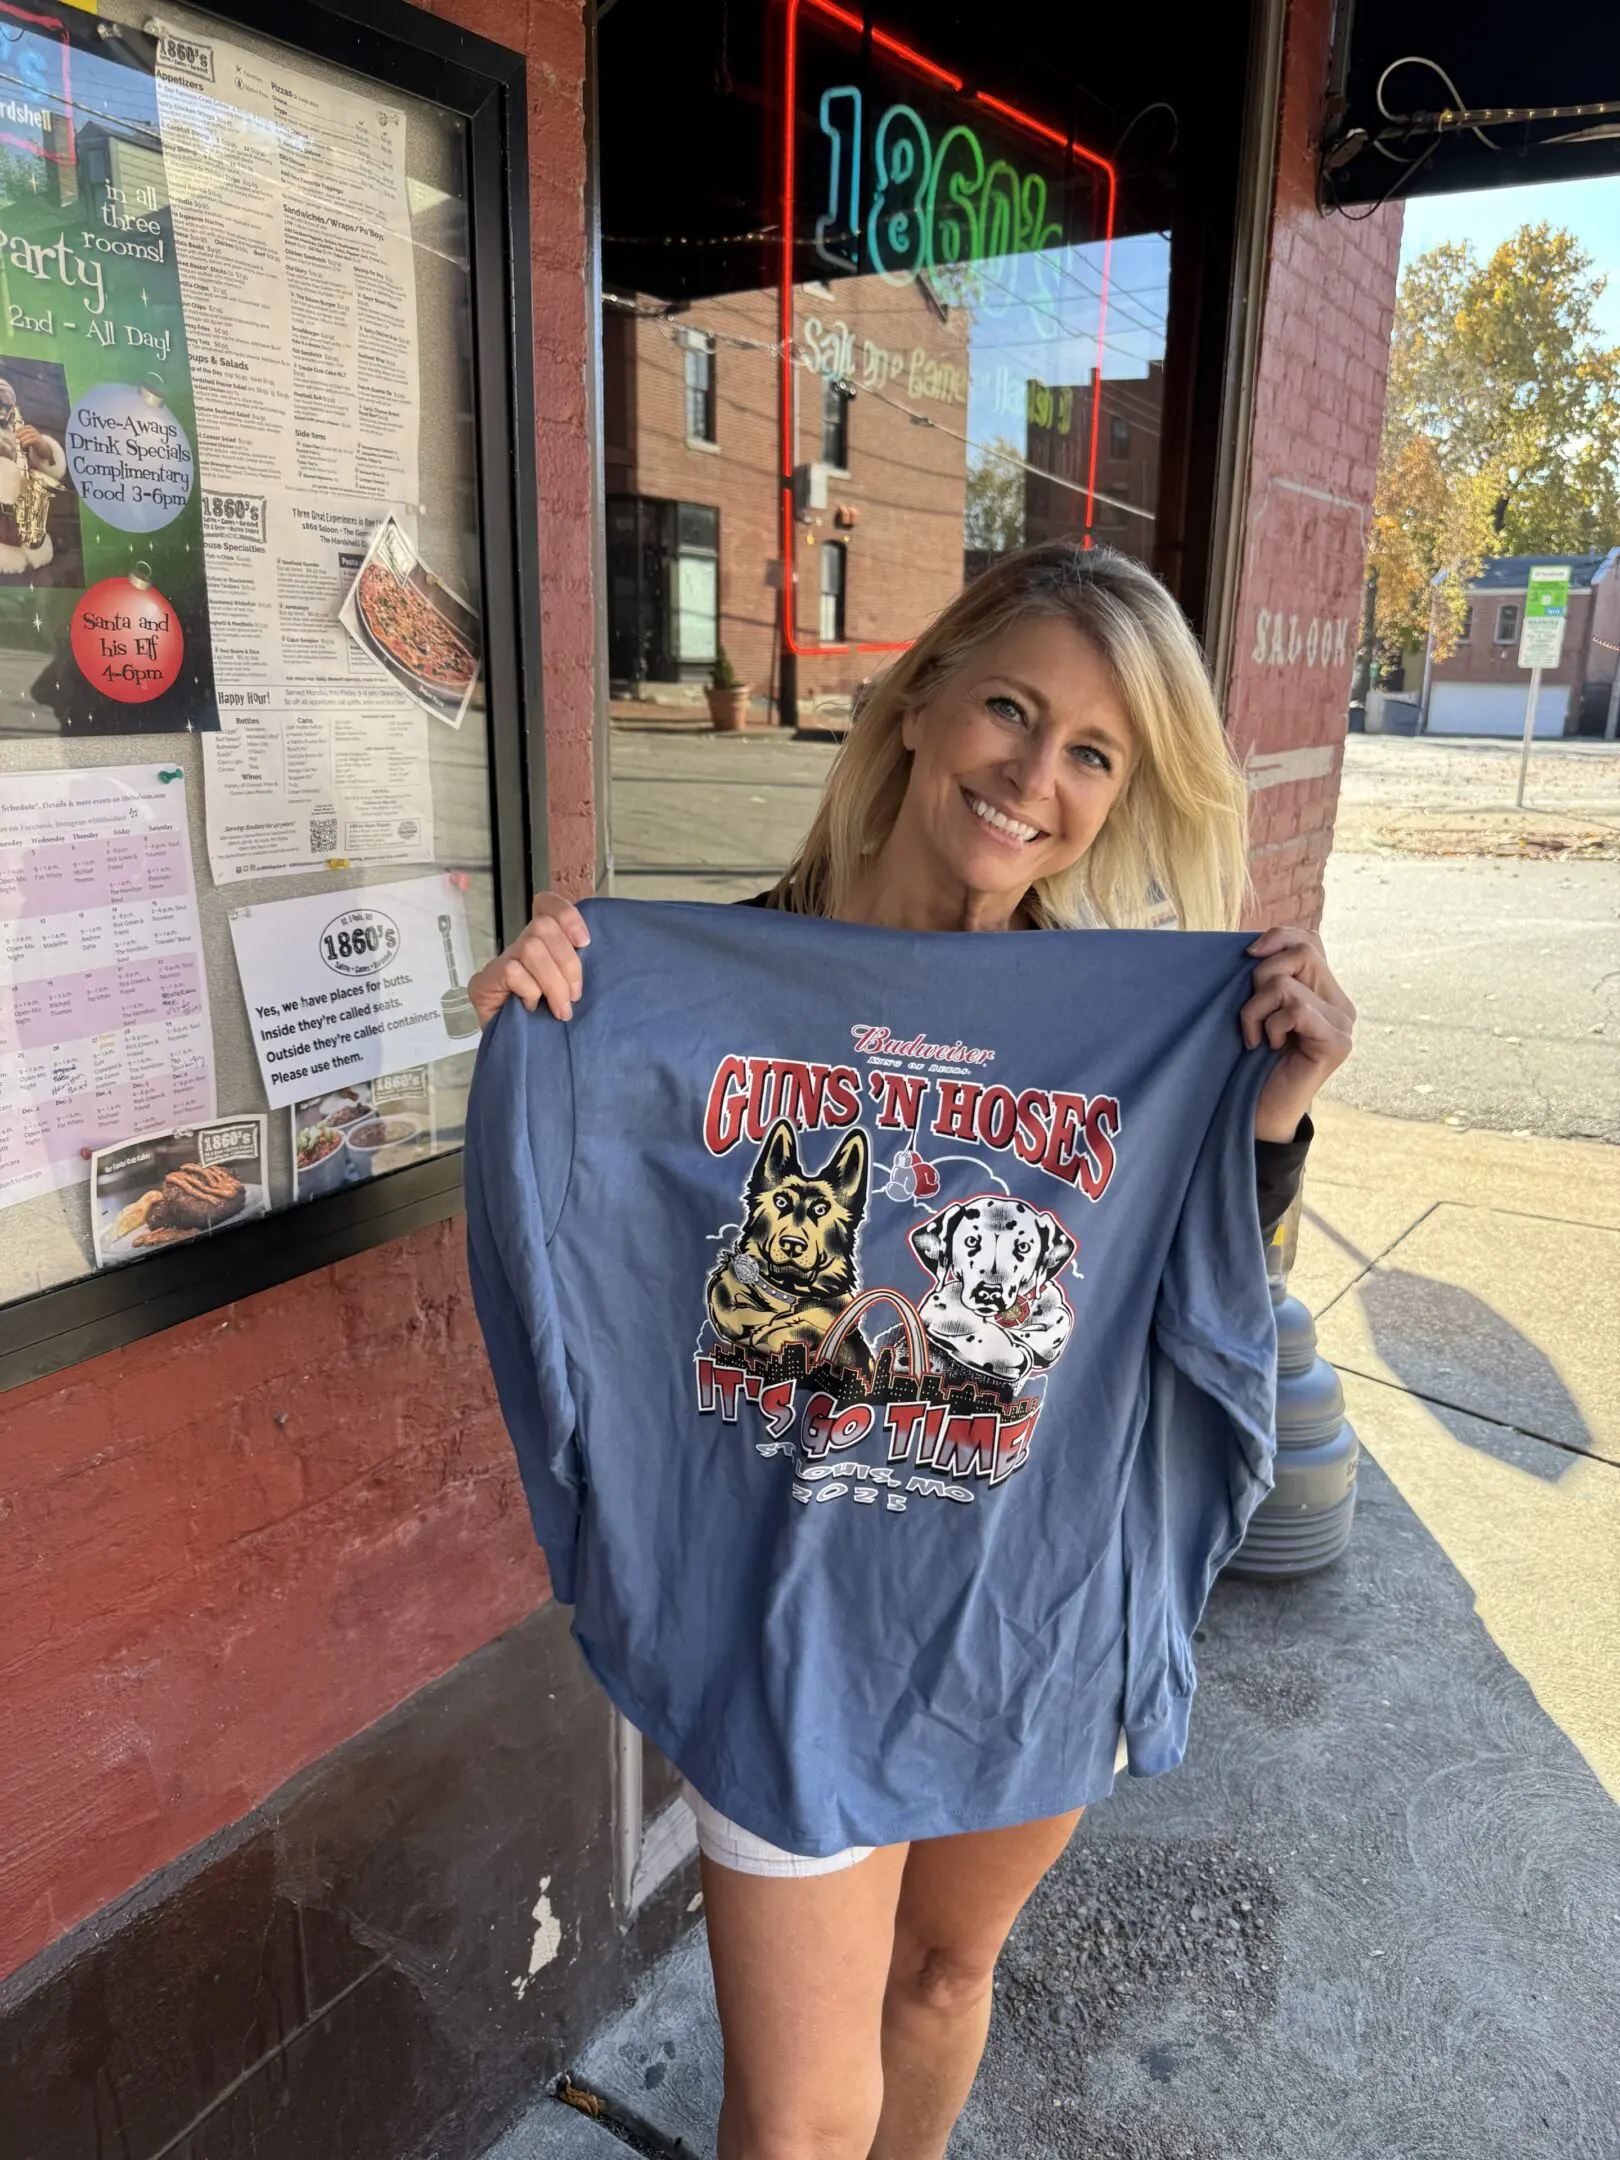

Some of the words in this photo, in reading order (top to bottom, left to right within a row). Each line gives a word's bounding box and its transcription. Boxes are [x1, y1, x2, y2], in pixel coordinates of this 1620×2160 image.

[156, 70, 204, 91] Appetizers
[271, 81, 293, 98] Pizzas
[104, 178, 126, 204] in
[136, 185, 158, 212] all
[101, 201, 161, 235] three
[81, 231, 164, 264] rooms!
[8, 304, 54, 334] 2nd
[86, 319, 116, 347] All
[124, 325, 172, 361] Day!
[188, 354, 209, 365] oups
[211, 355, 218, 365] &
[220, 357, 249, 371] Salads
[77, 408, 178, 444] Give-Aways
[295, 429, 310, 439] Side
[311, 431, 327, 441] Items
[68, 432, 122, 456] Drink
[126, 438, 191, 462] Specials
[73, 455, 190, 492] Complimentary
[79, 480, 125, 503] Food
[131, 485, 188, 510] 3-6pm
[202, 496, 260, 521] 1860's
[292, 507, 310, 518] Three
[311, 509, 325, 521] Great
[326, 511, 358, 525] Experiences
[302, 522, 318, 532] 1860
[318, 523, 339, 534] Saloon
[343, 526, 354, 536] The
[203, 541, 222, 550] ouse
[223, 542, 266, 553] Specialties
[320, 535, 332, 544] The
[332, 536, 360, 547] Hardshell
[83, 612, 132, 631] Santa
[138, 613, 170, 632] and
[99, 638, 128, 657] his
[134, 634, 159, 661] Elf
[1250, 607, 1349, 668] SALOON
[102, 664, 164, 685] 4-6pm
[217, 691, 245, 706] Happy
[235, 717, 260, 725] Bottles
[42, 799, 67, 809] Details
[75, 799, 91, 807] more
[31, 834, 65, 844] Wednesday
[72, 832, 99, 840] Thursday
[148, 824, 173, 832] Saturday
[324, 924, 397, 961] 1860's
[255, 1006, 281, 1019] Yes,
[282, 1000, 300, 1013] we
[300, 994, 328, 1010] have
[330, 985, 364, 1005] places
[366, 980, 382, 994] for
[383, 973, 413, 989] butts.
[260, 1022, 296, 1041] Inside
[298, 1014, 337, 1035] they're
[340, 1004, 372, 1021] called
[373, 997, 403, 1014] seats.
[266, 1040, 311, 1063] Outside
[313, 1033, 352, 1054] they're
[354, 1022, 385, 1040] called
[386, 1008, 441, 1032] containers.
[850, 1023, 996, 1065] Budweiser
[271, 1066, 309, 1085] Please
[310, 1059, 331, 1075] use
[331, 1051, 364, 1069] them.
[866, 1055, 903, 1068] KING
[907, 1061, 925, 1071] OF
[203, 1130, 252, 1151] 1860's
[703, 1053, 861, 1157] GUNS
[868, 1072, 929, 1131] 'N
[932, 1079, 1121, 1203] HOSES
[695, 1357, 798, 1438] IT'S
[800, 1391, 876, 1459] GO
[883, 1399, 1043, 1486] TIME!
[795, 1460, 902, 1489] LOUIS,
[905, 1475, 975, 1503] MO
[791, 1481, 907, 1513] 2025
